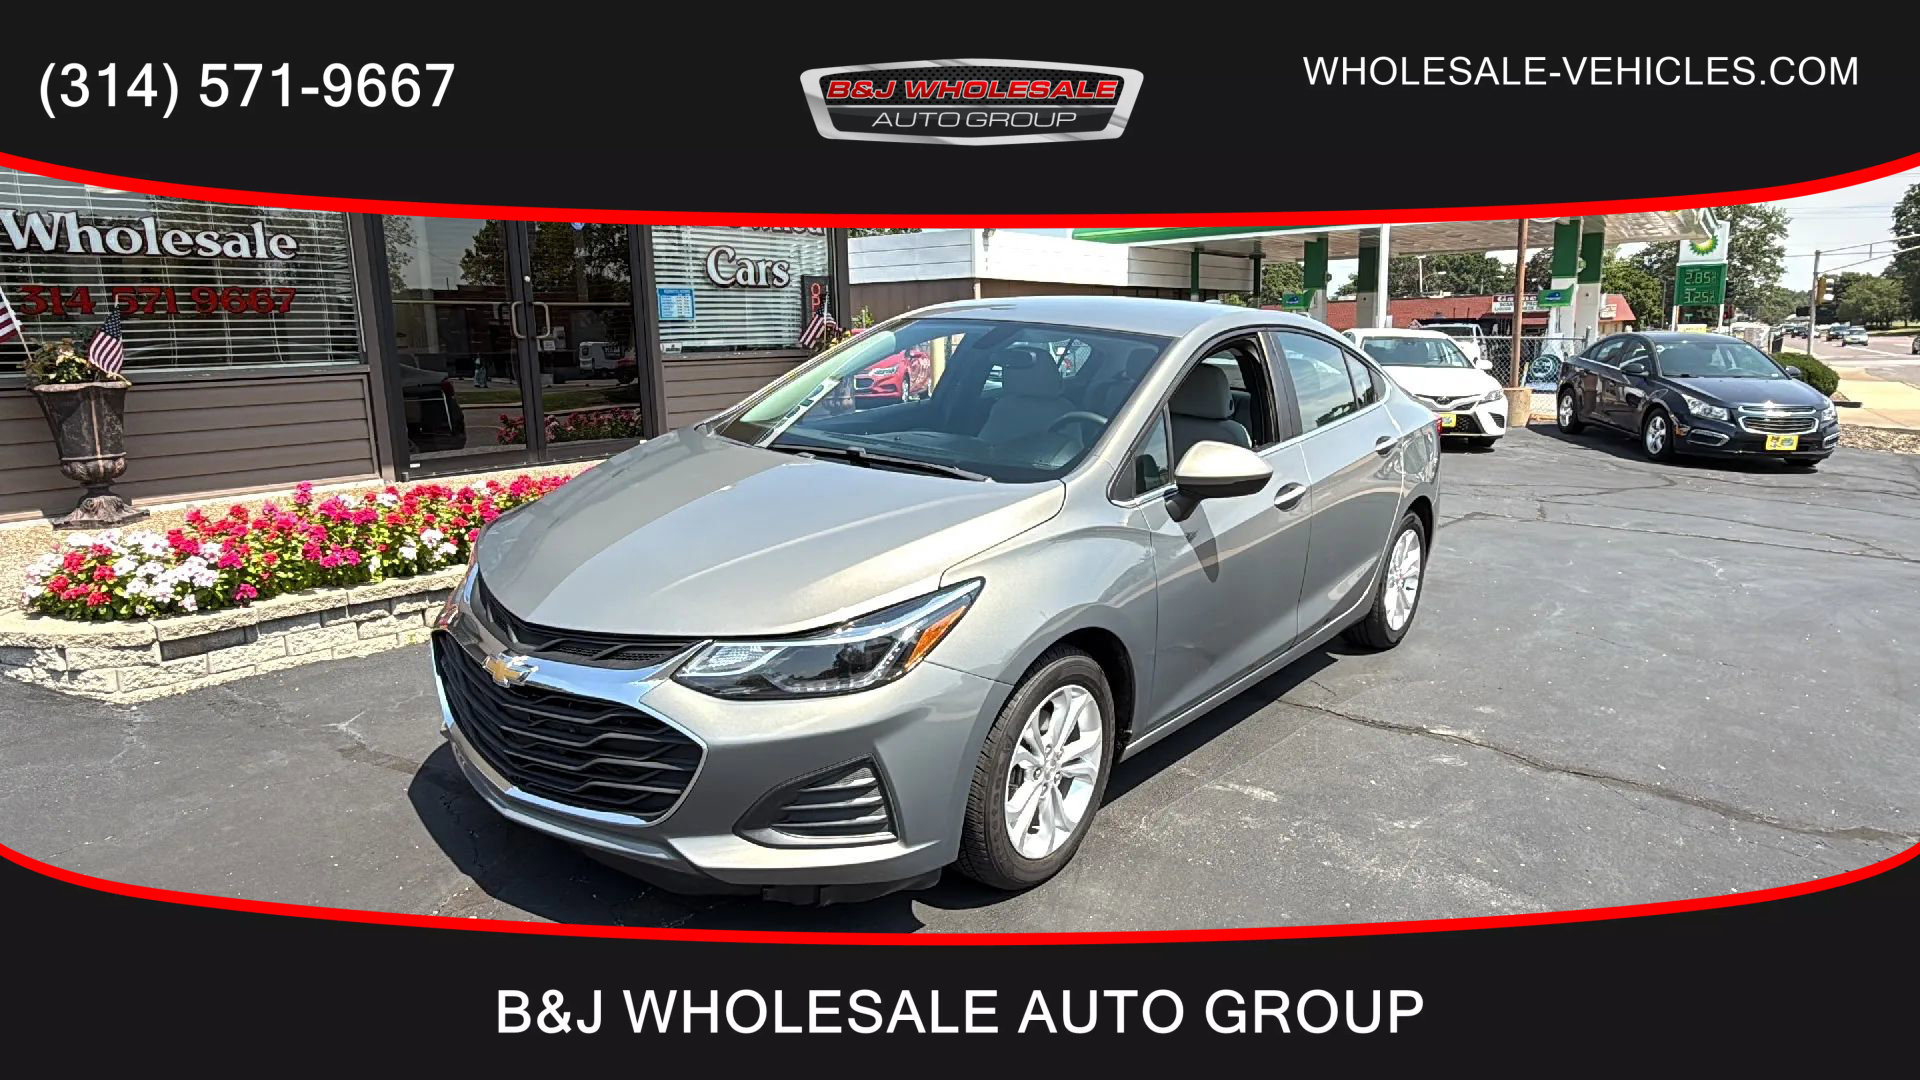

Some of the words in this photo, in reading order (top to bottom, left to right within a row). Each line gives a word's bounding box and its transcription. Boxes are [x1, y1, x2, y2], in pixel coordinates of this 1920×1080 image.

[0, 208, 298, 260] Wholesale
[706, 244, 791, 289] Cars
[18, 285, 96, 316] 314
[111, 285, 180, 316] 571
[190, 286, 297, 315] 9667
